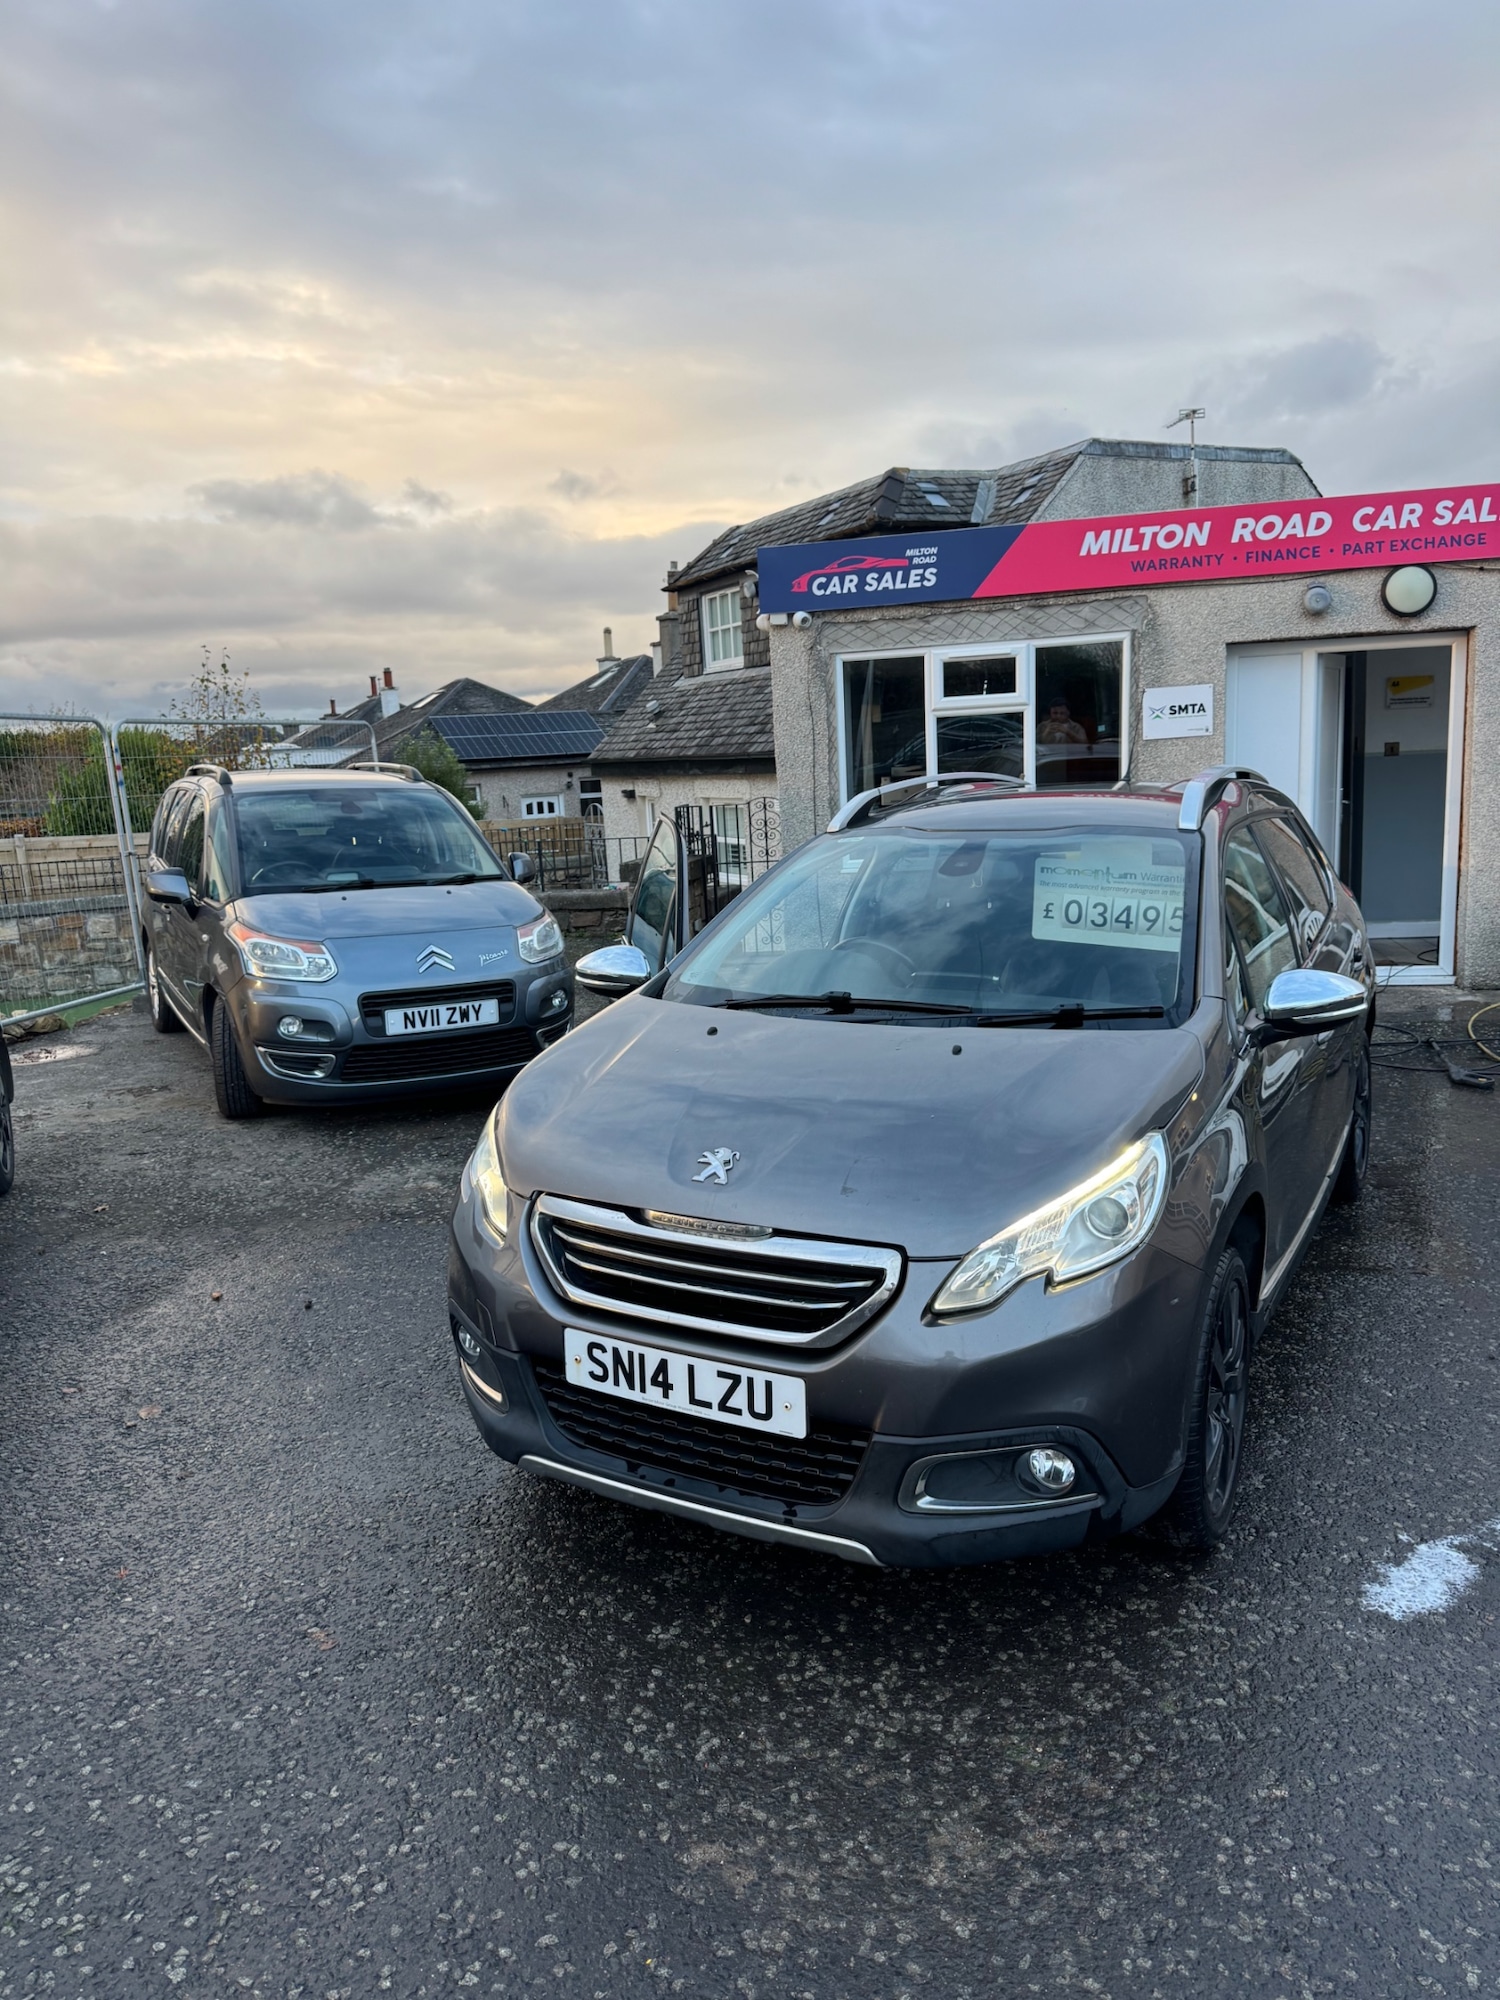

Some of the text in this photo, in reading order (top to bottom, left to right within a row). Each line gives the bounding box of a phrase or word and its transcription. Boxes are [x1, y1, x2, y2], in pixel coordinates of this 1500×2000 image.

[1079, 496, 1500, 556] MILTON ROAD CAR SAL
[905, 546, 938, 557] MILTON
[912, 555, 937, 565] ROAD
[1130, 532, 1488, 573] WARRANTY FINANCE PART EXCHANGE
[811, 567, 938, 597] CAR SALES
[1169, 702, 1207, 716] SMTA
[1040, 866, 1137, 884] momentum
[1051, 881, 1067, 889] most
[1068, 883, 1099, 891] advanced
[1100, 886, 1130, 894] warranty
[1131, 887, 1159, 896] program
[1042, 899, 1184, 934] £ 03495
[403, 1003, 483, 1030] NV11 ZWY
[586, 1340, 774, 1422] SN14 LZU
